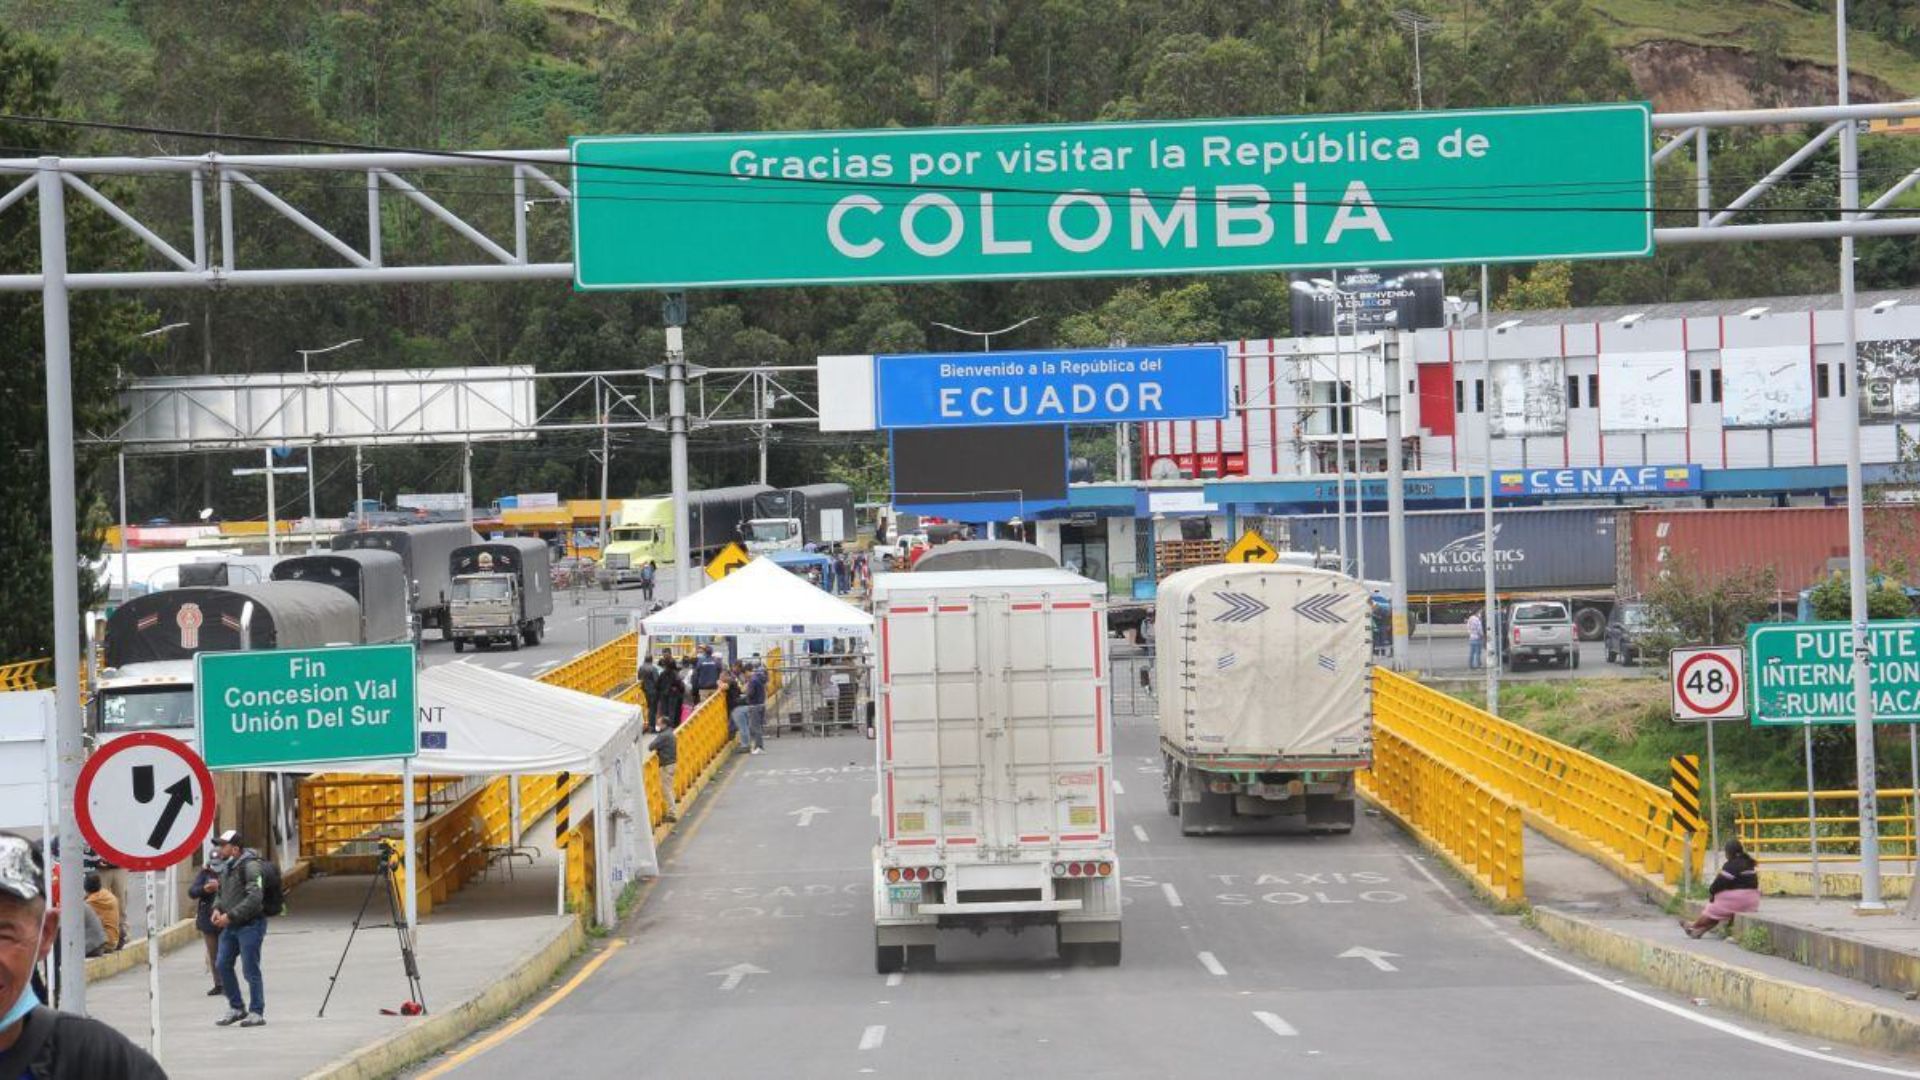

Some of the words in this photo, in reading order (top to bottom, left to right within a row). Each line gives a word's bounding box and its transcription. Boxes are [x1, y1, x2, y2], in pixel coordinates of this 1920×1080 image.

[730, 147, 893, 181] Gracias
[910, 149, 981, 184] por
[997, 140, 1132, 174] visitar
[1151, 138, 1185, 168] la
[1203, 130, 1419, 174] República
[1438, 127, 1490, 158] de
[826, 180, 1392, 258] COLOMBIA
[940, 362, 1024, 377] Bienvenido
[1028, 364, 1038, 375] a
[1042, 360, 1055, 374] la
[1060, 357, 1135, 377] República
[1140, 357, 1162, 372] del
[940, 381, 1163, 417] ECUADOR
[1530, 467, 1658, 488] CENAF
[1419, 552, 1448, 565] NYK
[1453, 548, 1525, 564] LOGITICS
[290, 657, 326, 680] Fin
[224, 682, 348, 708] Concesion
[355, 678, 397, 701] Vial
[1686, 668, 1724, 694] 48
[231, 708, 299, 734] Unión
[307, 706, 343, 730] Del
[351, 705, 391, 726] Sur
[1209, 871, 1390, 885] TAXIS
[1214, 889, 1408, 905] SOLO
